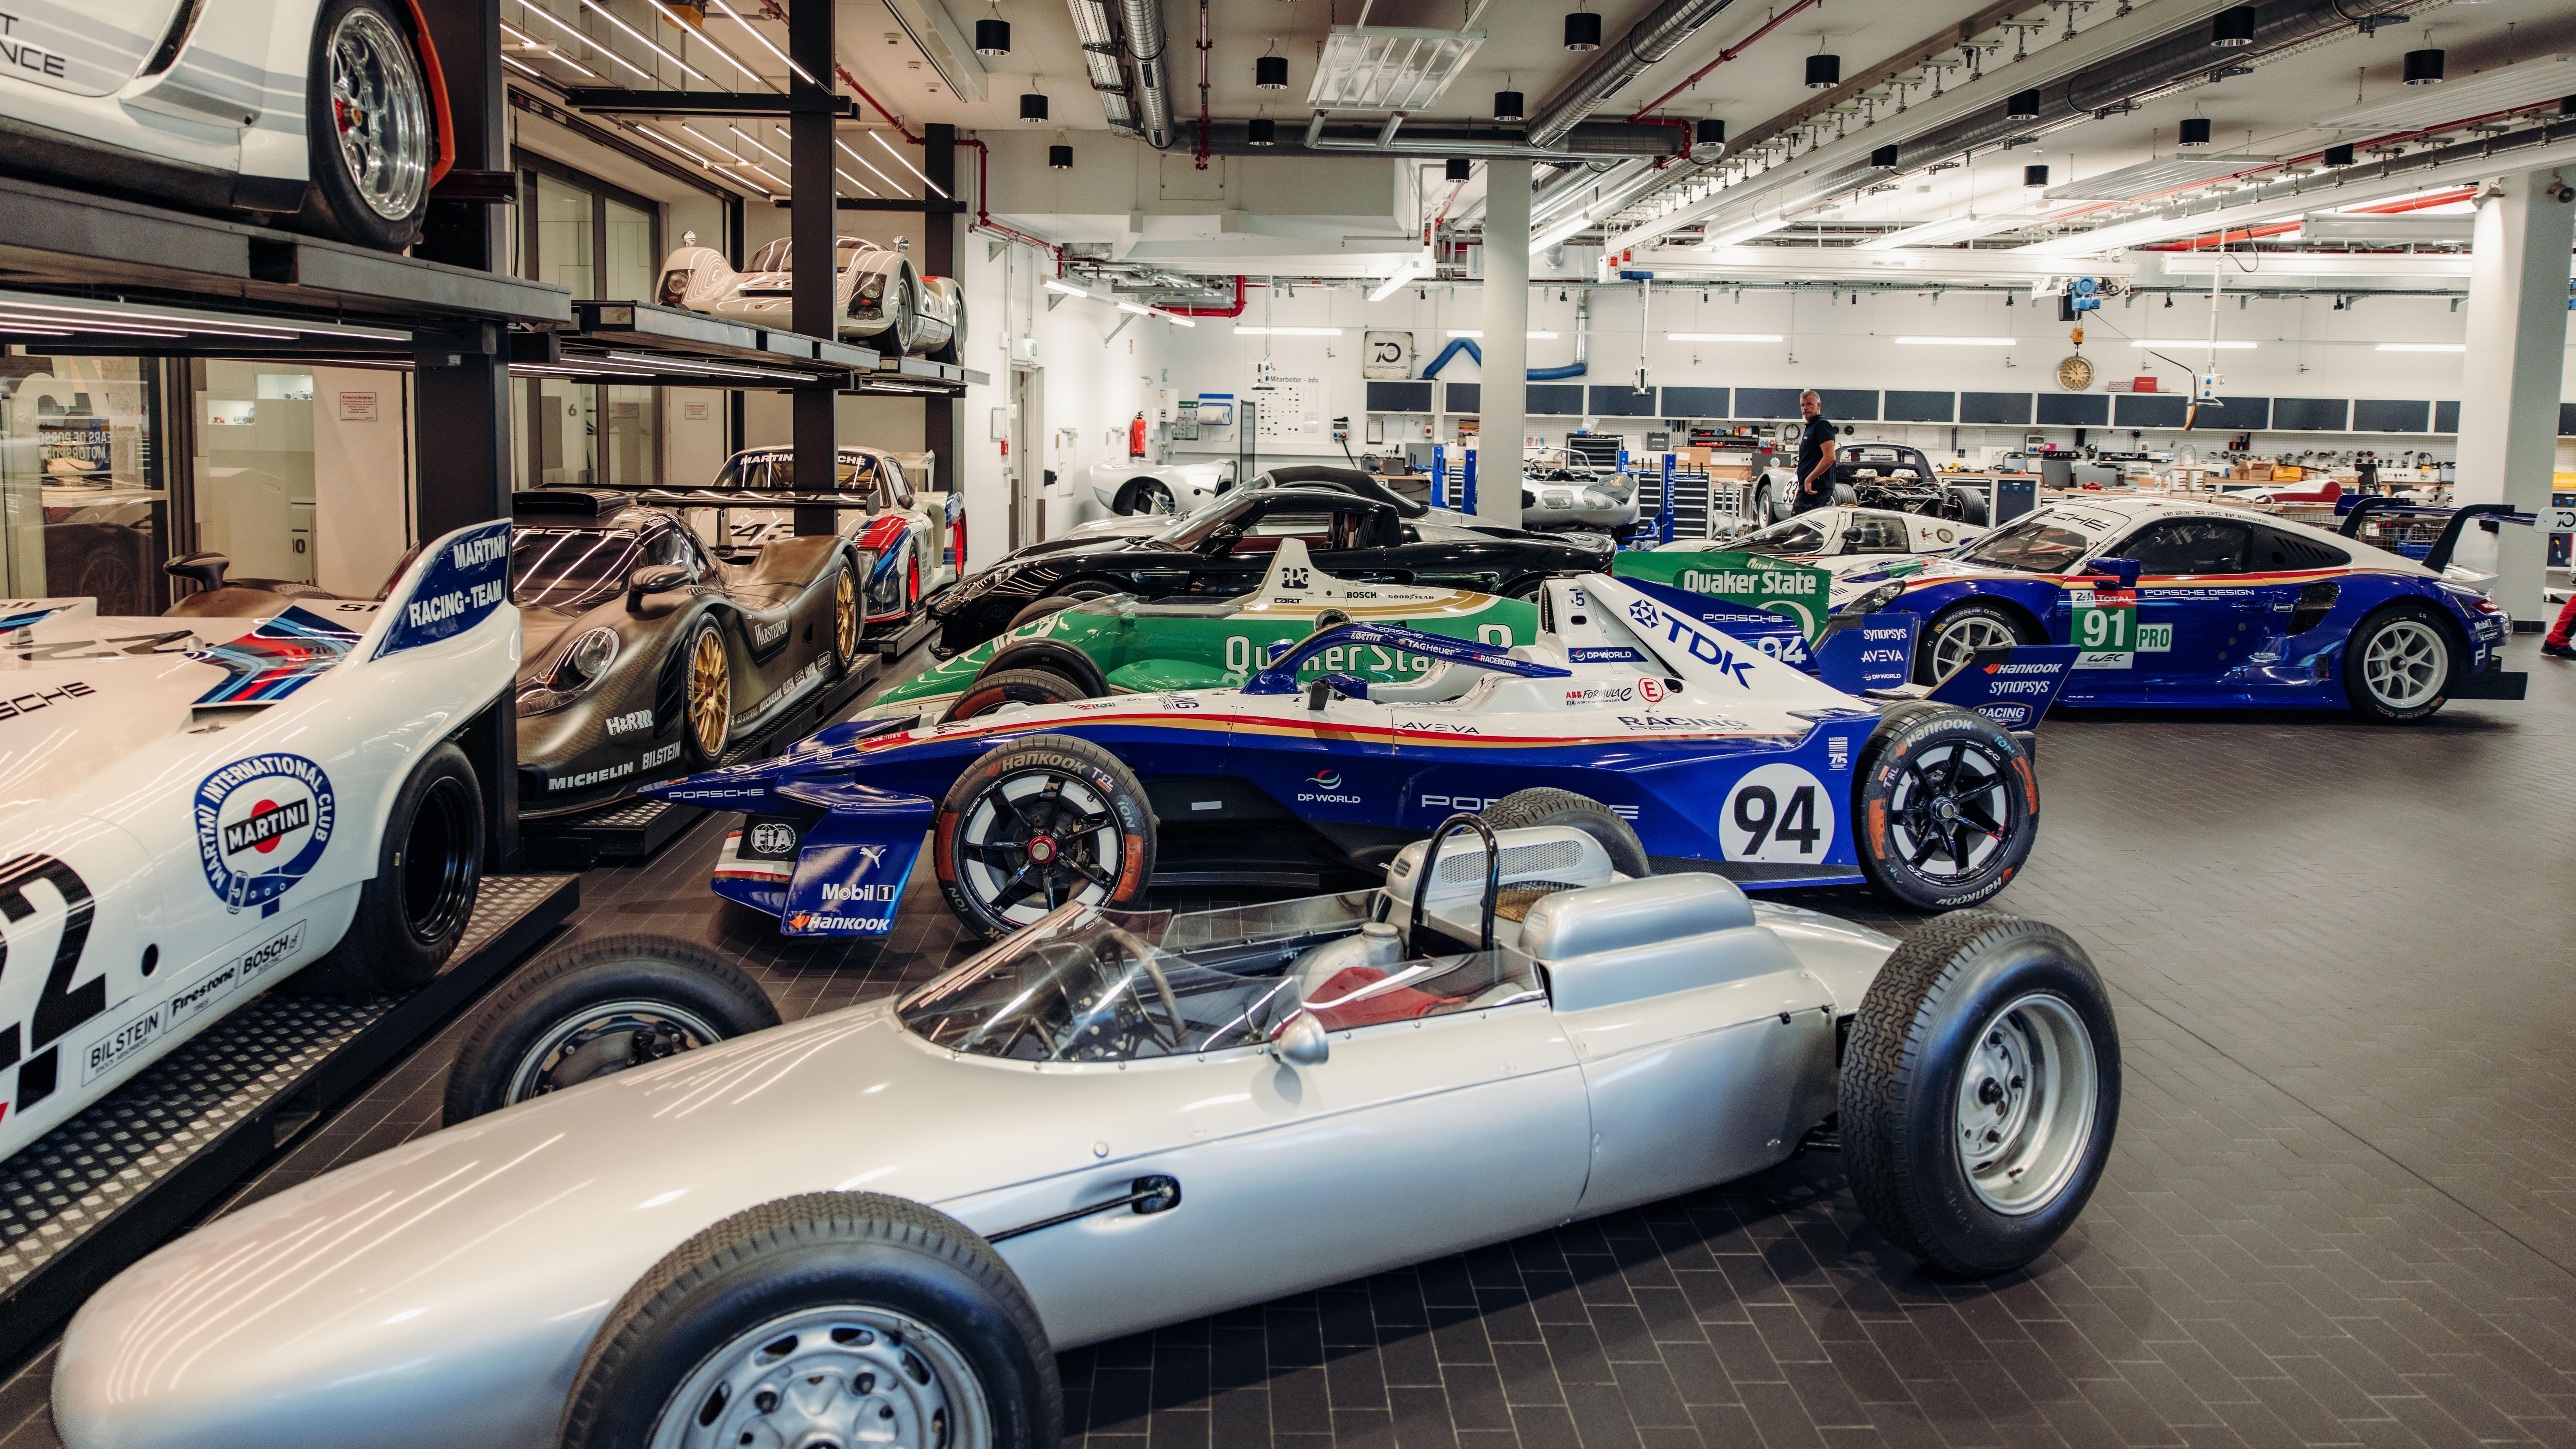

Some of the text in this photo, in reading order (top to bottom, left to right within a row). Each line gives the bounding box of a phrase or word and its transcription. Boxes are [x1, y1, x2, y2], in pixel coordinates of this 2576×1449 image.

[740, 454, 793, 465] MARTIN
[1667, 469, 1675, 514] LONGUS
[2238, 514, 2270, 524] MAKOWIECKI
[454, 535, 506, 569] MARTINI
[2078, 536, 2117, 566] www.porsche.com
[1683, 569, 1757, 594] Quaker
[1761, 569, 1817, 594] State
[1703, 613, 1783, 622] PORSCHE
[1946, 607, 1981, 623] MICHELIN
[2084, 609, 2125, 647] 91
[754, 619, 787, 647] WARSTEINER
[1351, 632, 1382, 642] LOCTITE
[1378, 627, 1424, 638] PORSCHE
[2139, 628, 2170, 647] PRO
[1225, 635, 1361, 673] Quer
[1480, 654, 1516, 668] RACEBORN
[1599, 651, 1632, 659] WORLD
[1662, 612, 1756, 690] TDK
[1758, 636, 1807, 664] 94
[1861, 650, 1904, 663] AVEVA
[2087, 653, 2125, 662] WEC
[1400, 722, 1479, 734] AVEVA
[1617, 716, 1749, 728] RACING
[642, 741, 681, 770] BILSTEIN
[1829, 753, 1848, 764] 75
[201, 756, 321, 806] INTERNATIONAL
[548, 762, 633, 790] MICHELIN
[668, 788, 764, 799] PORSCHE
[1297, 794, 1360, 803] DP WORLD
[228, 802, 308, 851] MARTINI
[314, 793, 332, 842] CLUB
[1734, 785, 1820, 856] 94
[198, 805, 225, 887] MARTINI
[821, 883, 874, 901] Mobil
[243, 935, 289, 975] BOSCH
[172, 967, 235, 1018] Firestone
[91, 1012, 159, 1069] BILSTEIN
